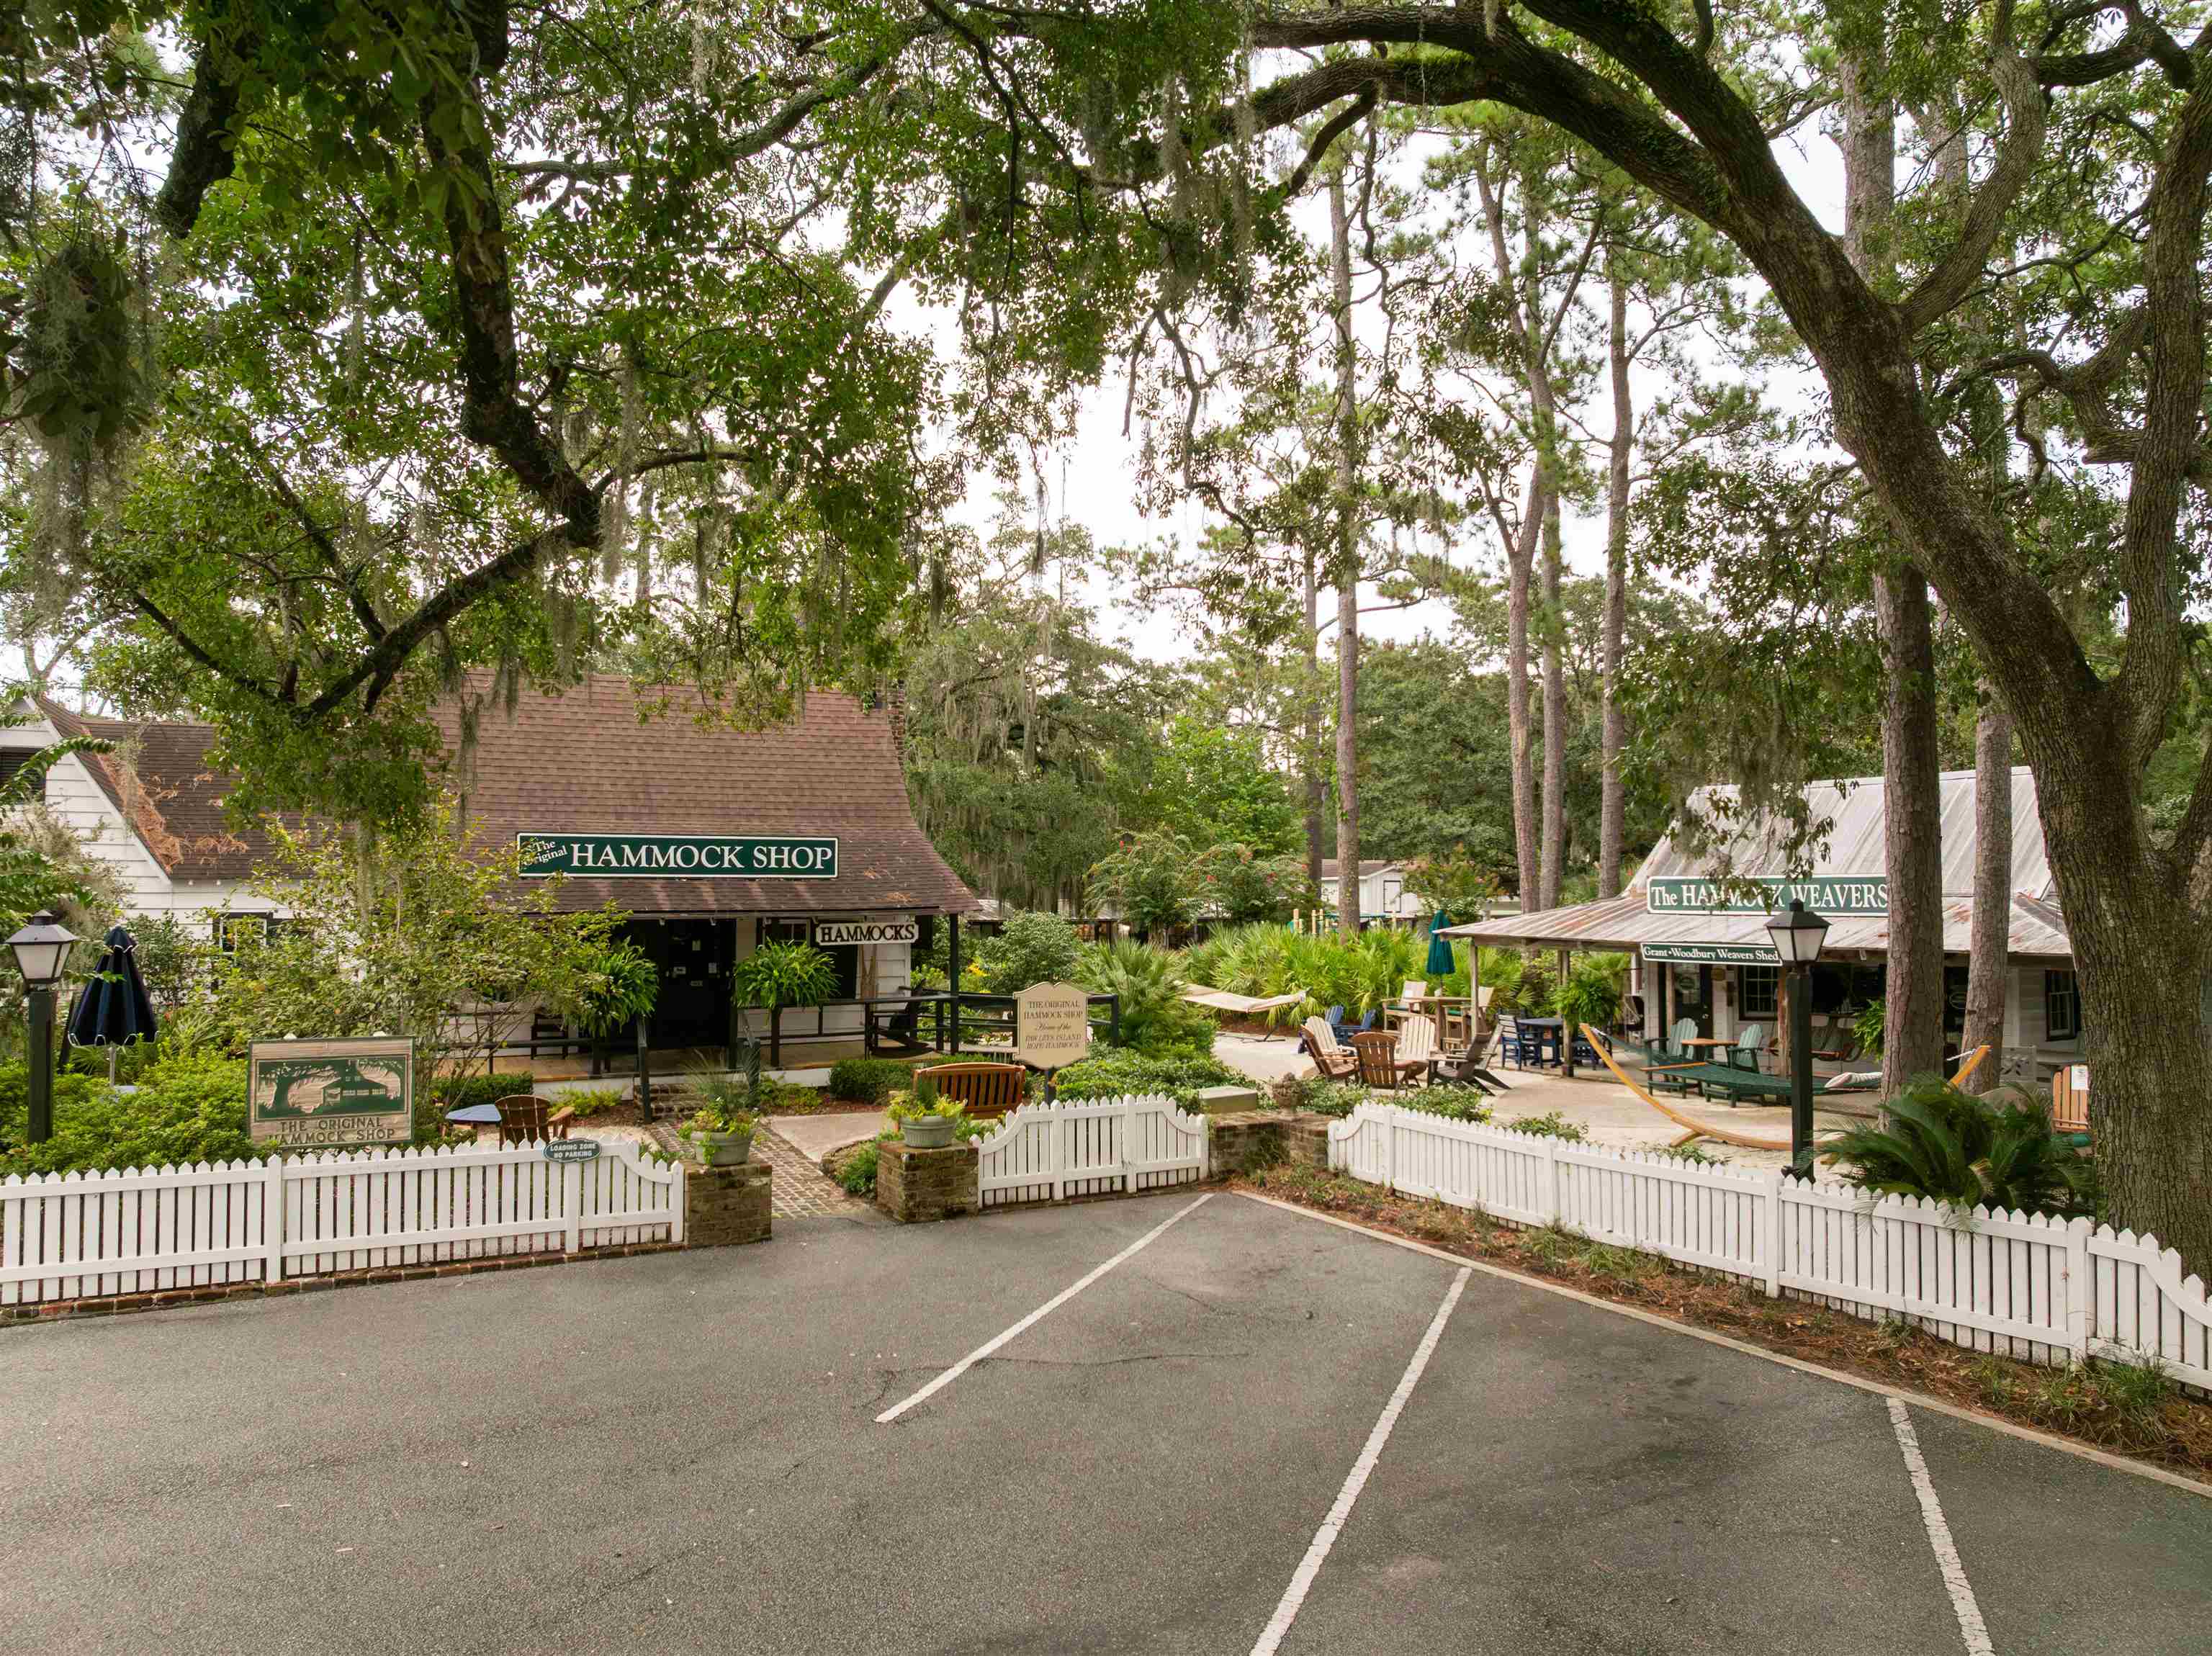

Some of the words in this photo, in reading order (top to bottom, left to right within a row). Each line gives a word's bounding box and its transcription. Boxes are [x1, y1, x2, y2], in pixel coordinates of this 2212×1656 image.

[533, 840, 555, 852] The
[570, 843, 743, 868] HAMMOCK
[753, 846, 833, 869] SHOP
[1652, 886, 1678, 906] The
[820, 924, 916, 943] HAMMOCKS
[1717, 949, 1754, 959] Weavers
[1755, 950, 1779, 960] Shed
[1044, 1000, 1079, 1009] ORIGINAL
[1024, 1011, 1062, 1020] HAMMOCK
[1064, 1011, 1083, 1020] SHOP
[280, 1120, 307, 1132] THE
[318, 1117, 383, 1130] ORIGINAL
[356, 1128, 395, 1140] SHOP
